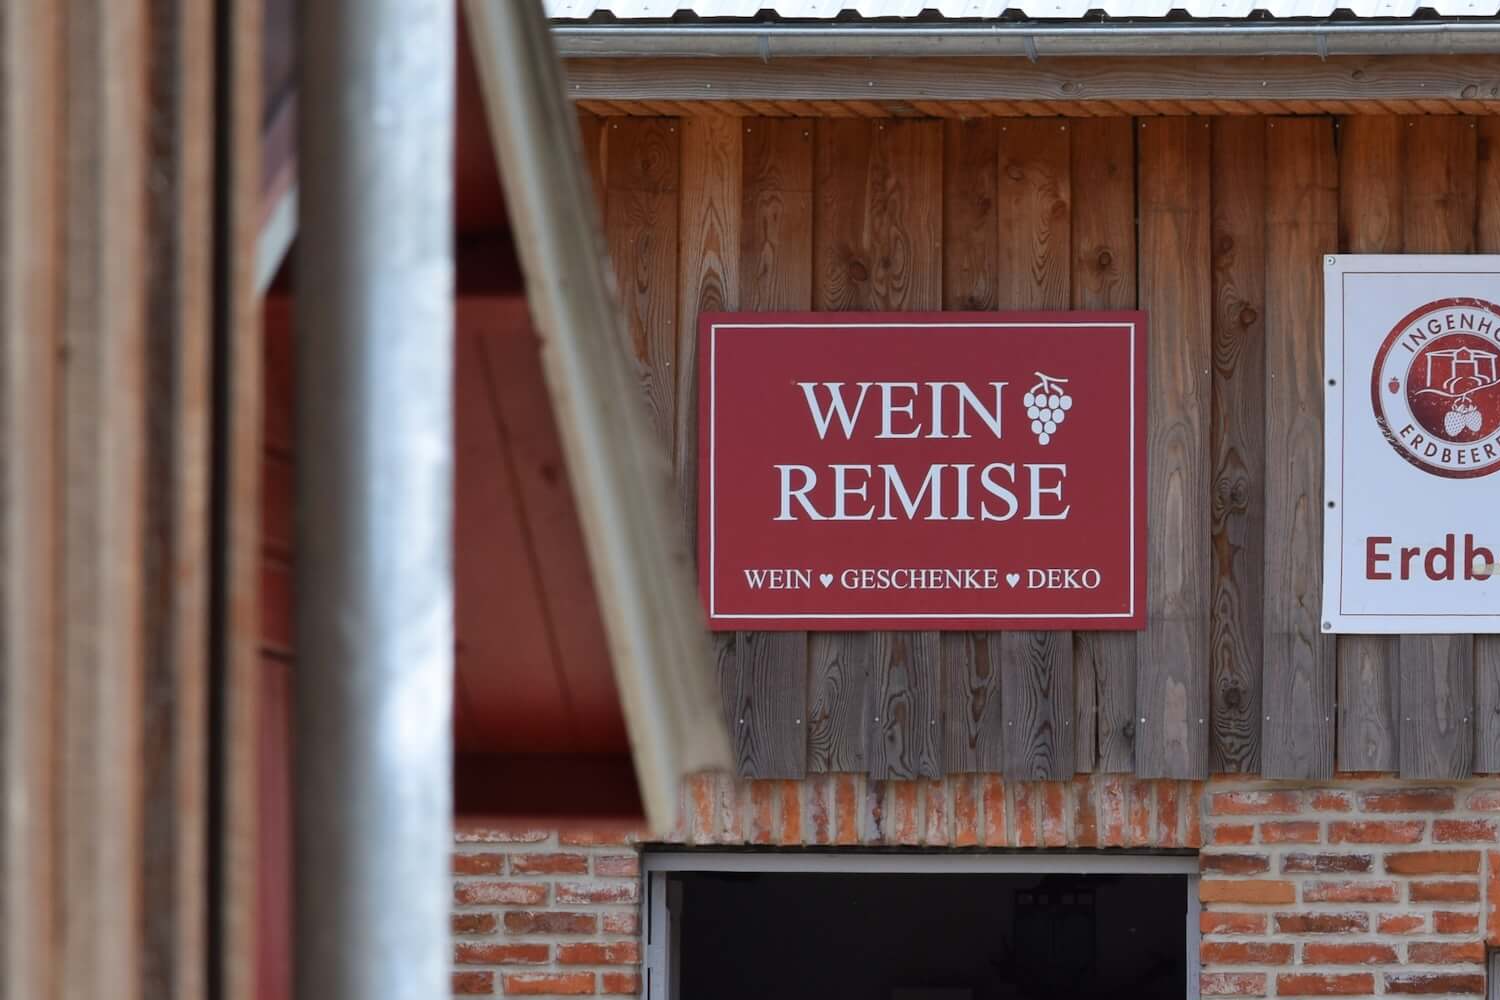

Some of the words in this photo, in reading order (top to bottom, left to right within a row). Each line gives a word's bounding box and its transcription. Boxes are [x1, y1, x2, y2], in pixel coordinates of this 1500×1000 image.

[797, 381, 1009, 440] WEIN
[773, 462, 1071, 522] REMISE
[743, 568, 812, 590] WEIN
[840, 568, 999, 590] GESCHENKE
[1027, 568, 1101, 590] DEKO
